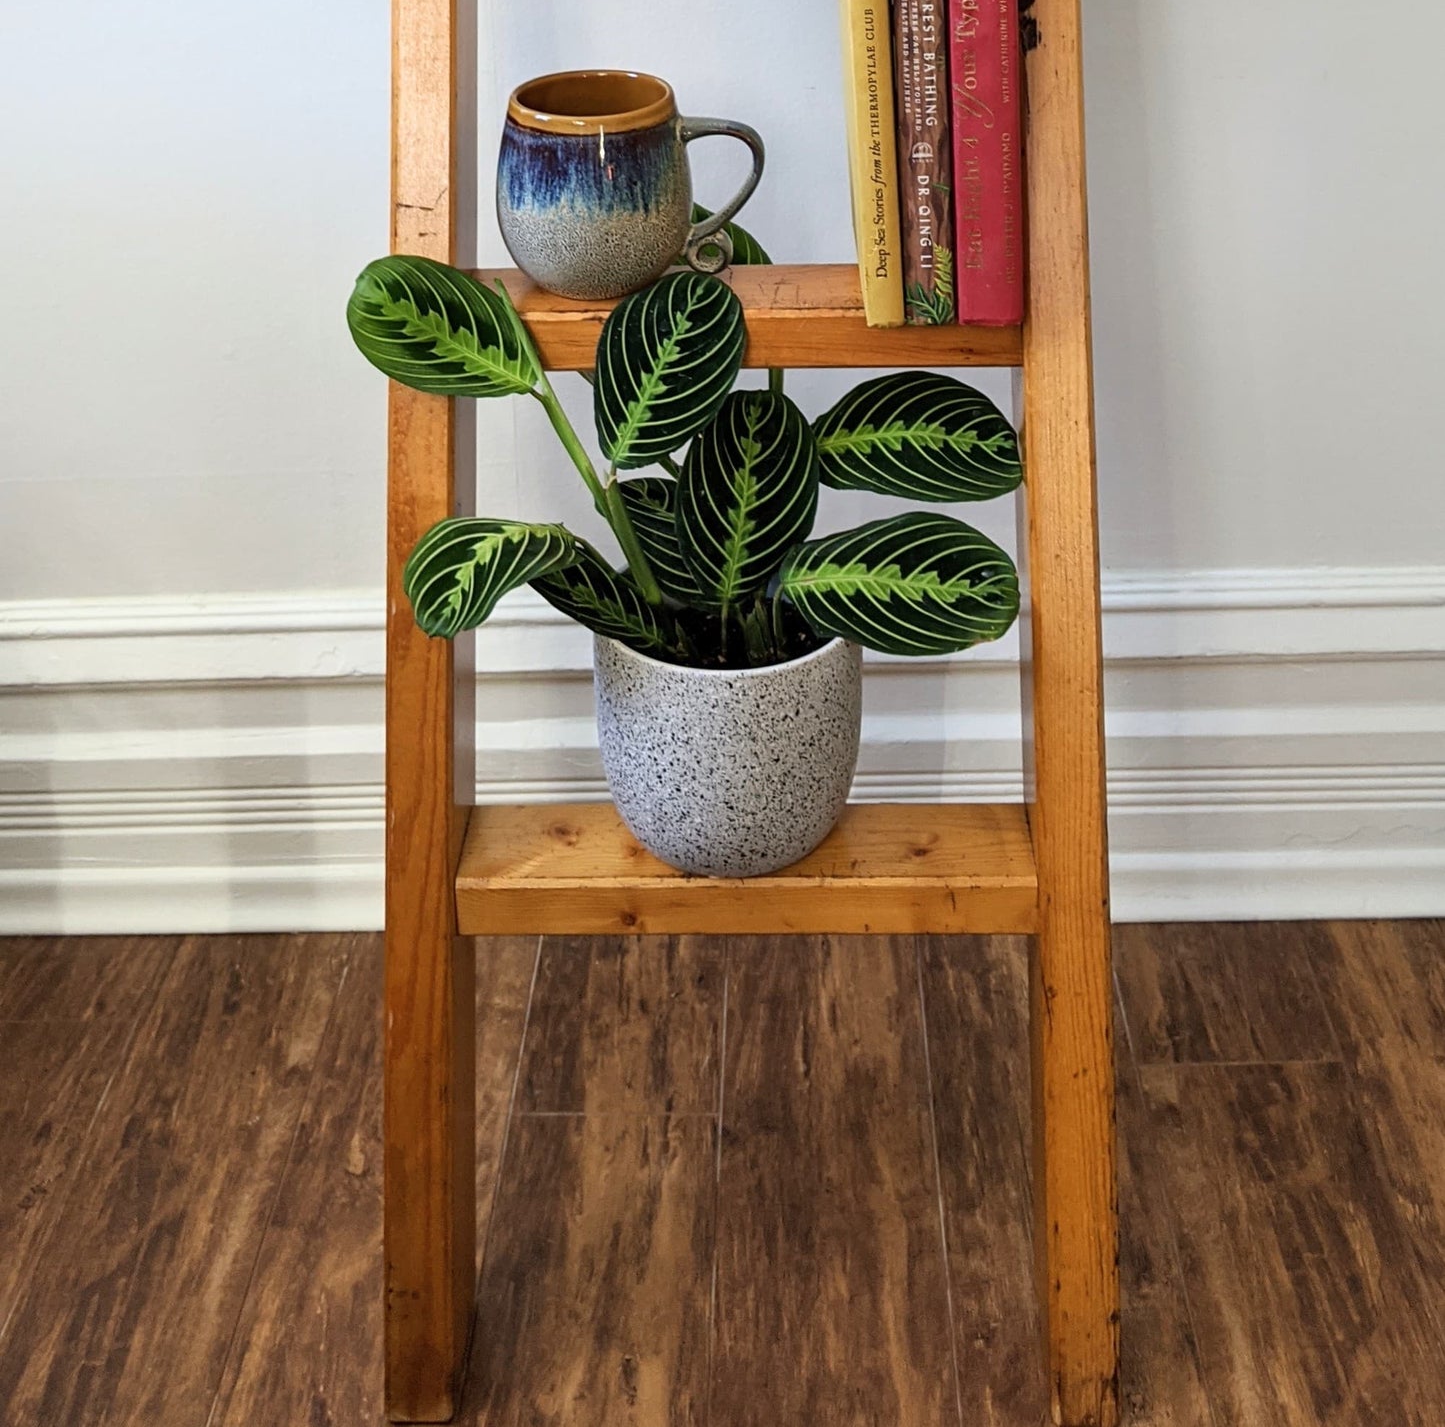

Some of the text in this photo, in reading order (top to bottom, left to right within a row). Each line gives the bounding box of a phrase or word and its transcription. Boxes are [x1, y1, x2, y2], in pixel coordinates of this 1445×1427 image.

[911, 0, 919, 32] TREES
[912, 35, 920, 54] CAN
[1000, 18, 1009, 75] CATHERINE
[903, 59, 911, 114] HAPPINESS
[923, 52, 938, 127] BATHING
[1001, 78, 1010, 103] WITH
[864, 8, 890, 279] Deep Sea Stories from the THERMOPYLAE CLUB
[962, 135, 979, 149] 4
[917, 175, 930, 201] DR.
[918, 205, 932, 247] QING
[920, 254, 933, 269] LI
